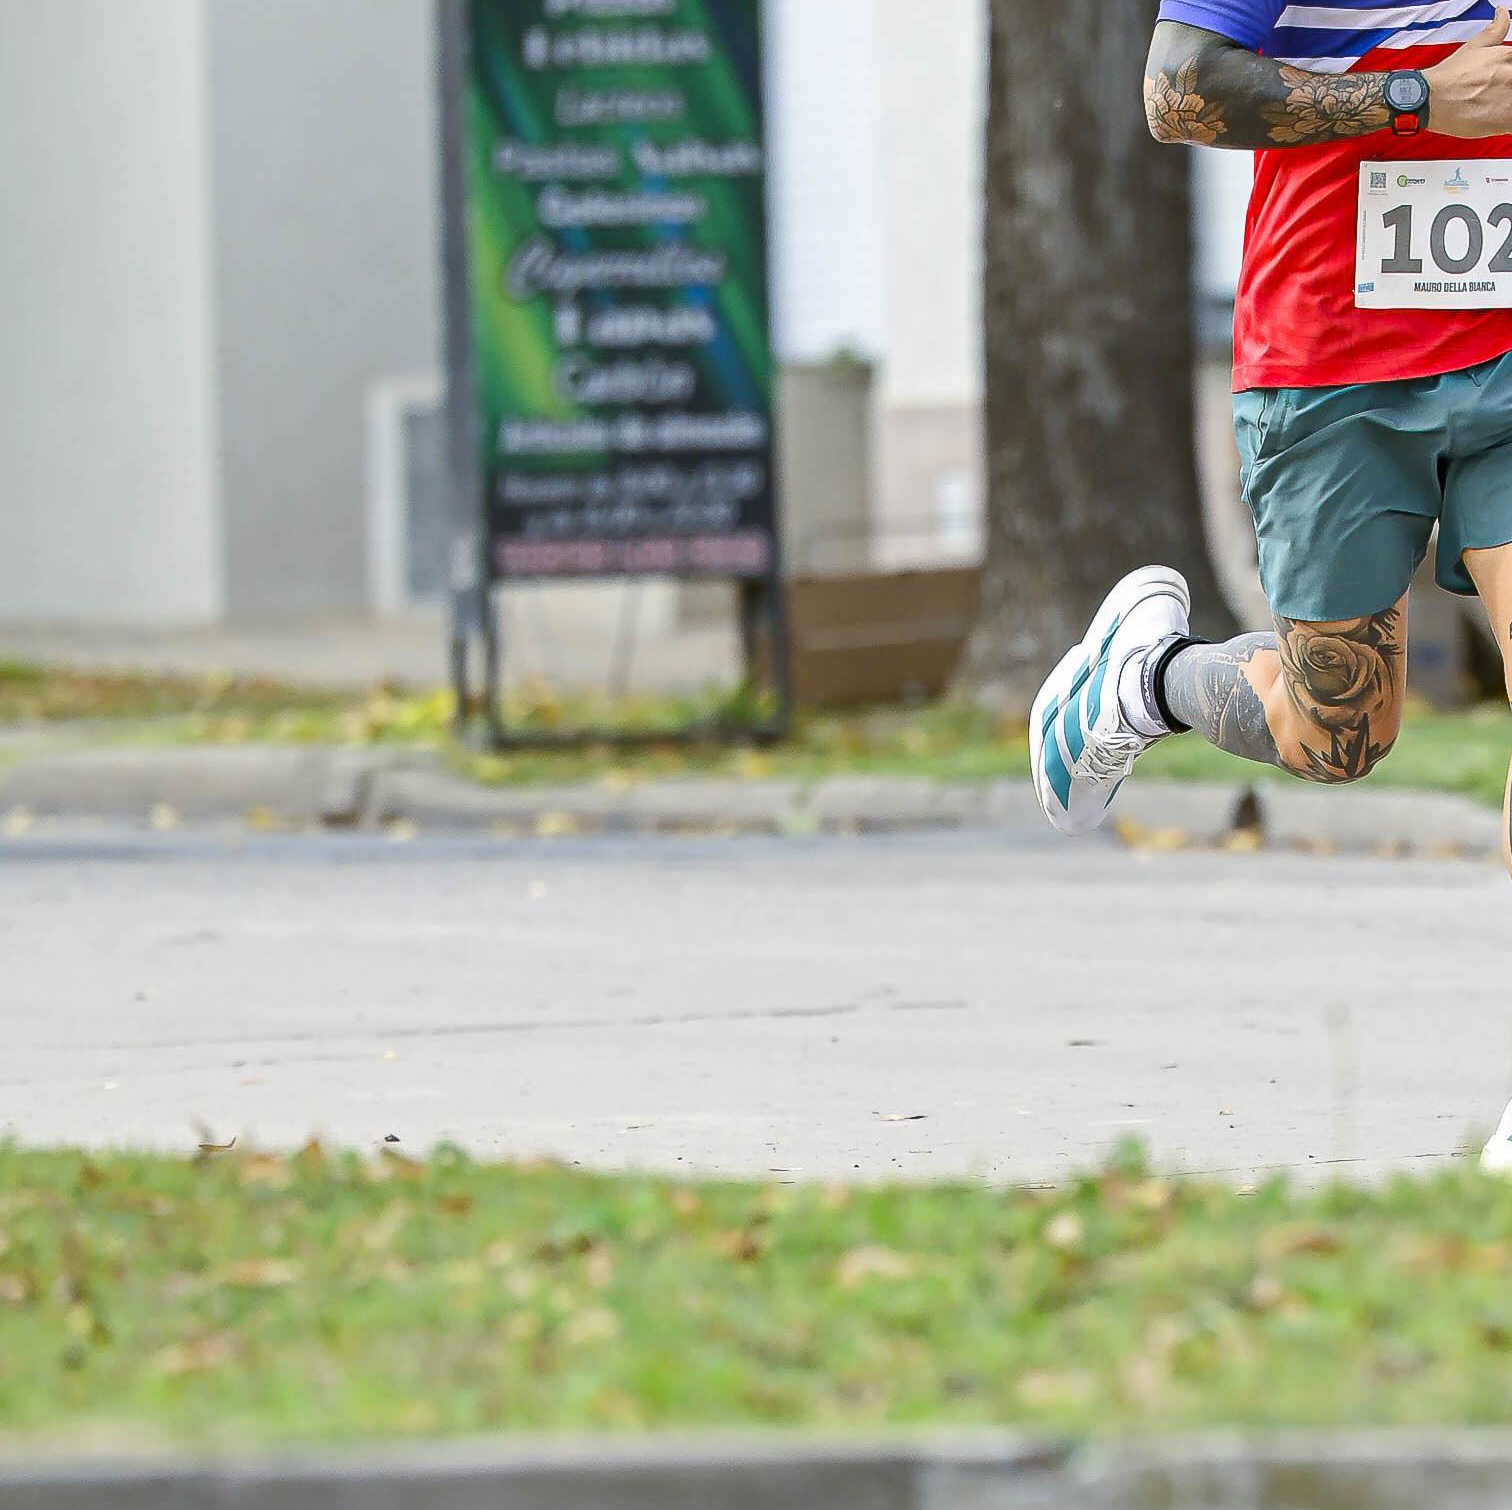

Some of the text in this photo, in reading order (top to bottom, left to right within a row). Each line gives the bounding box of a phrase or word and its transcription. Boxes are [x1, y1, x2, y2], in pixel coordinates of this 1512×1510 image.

[1413, 280, 1497, 293] MAURO DELLA BIANCA
